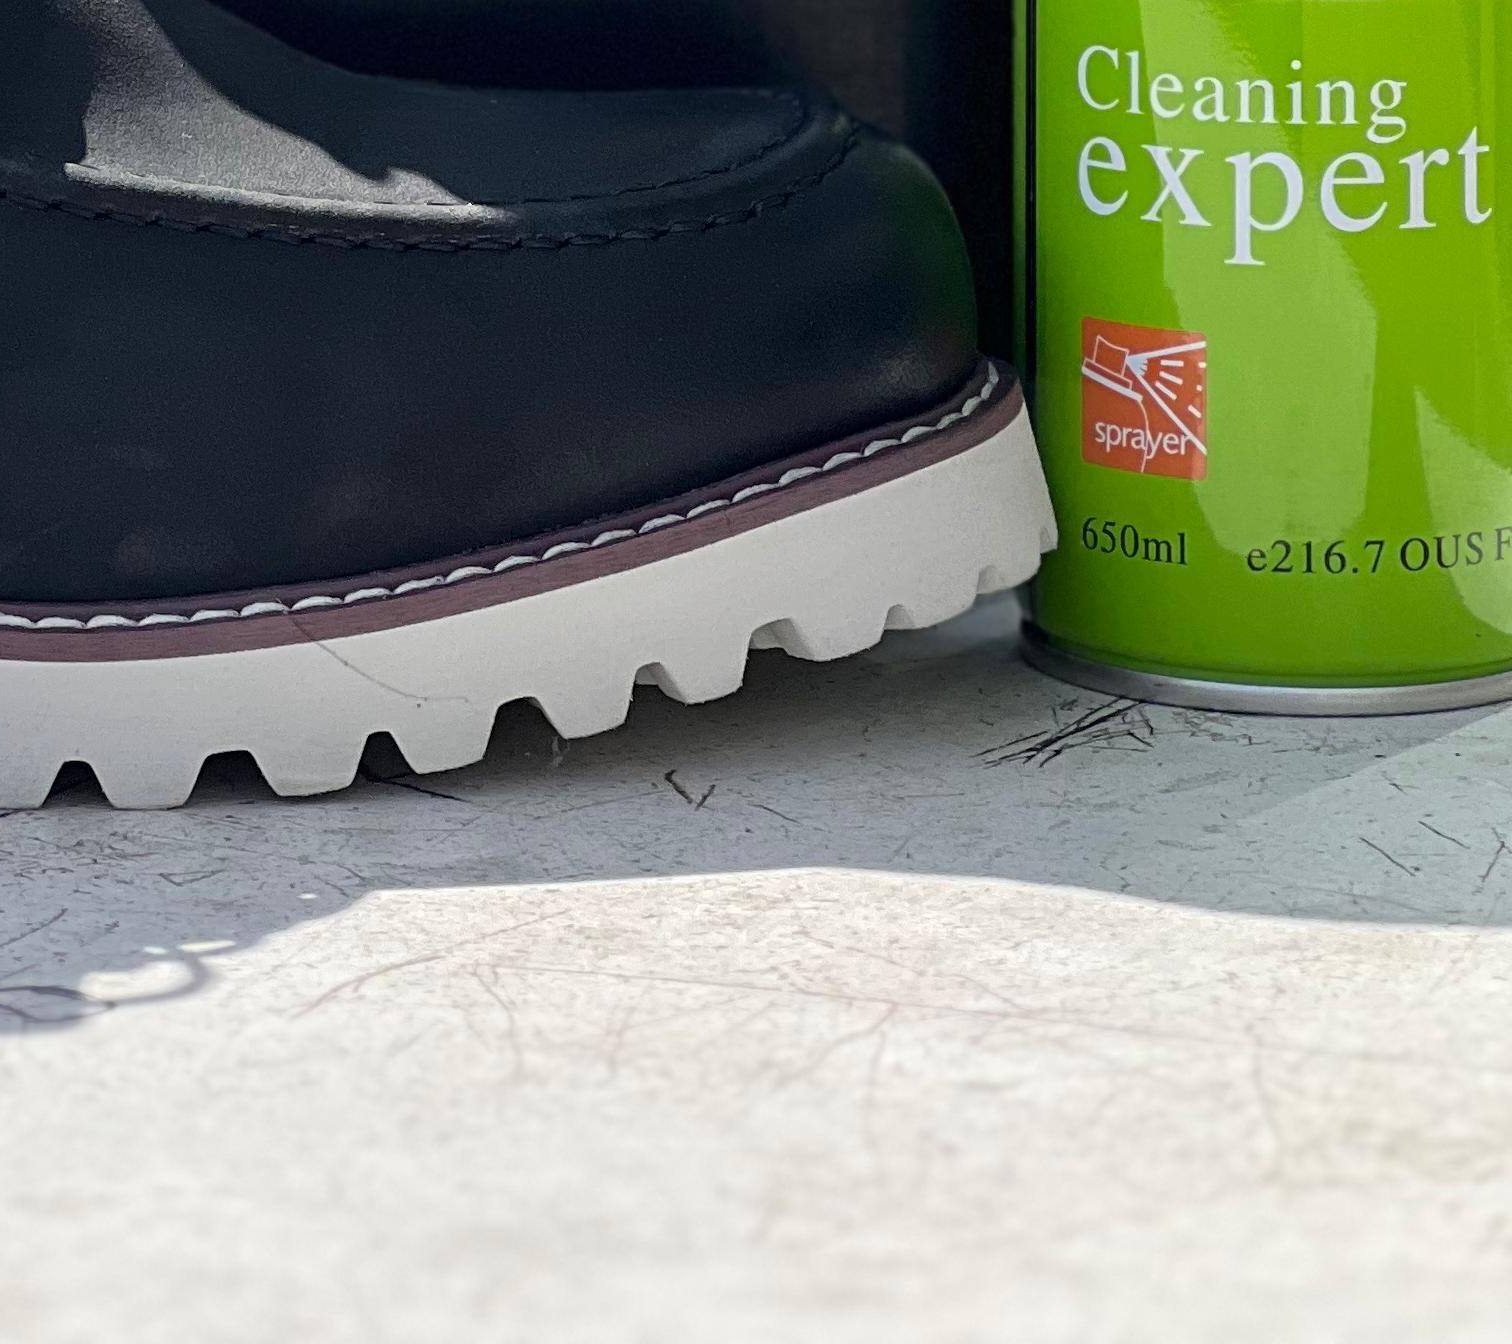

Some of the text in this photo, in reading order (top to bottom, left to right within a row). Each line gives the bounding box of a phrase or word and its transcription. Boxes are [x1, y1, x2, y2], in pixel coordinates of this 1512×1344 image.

[1077, 44, 1408, 145] Cleaning
[1078, 125, 1493, 266] expert
[1094, 419, 1191, 460] sprayer
[1081, 517, 1189, 567] 650ml
[1399, 531, 1486, 572] OUS
